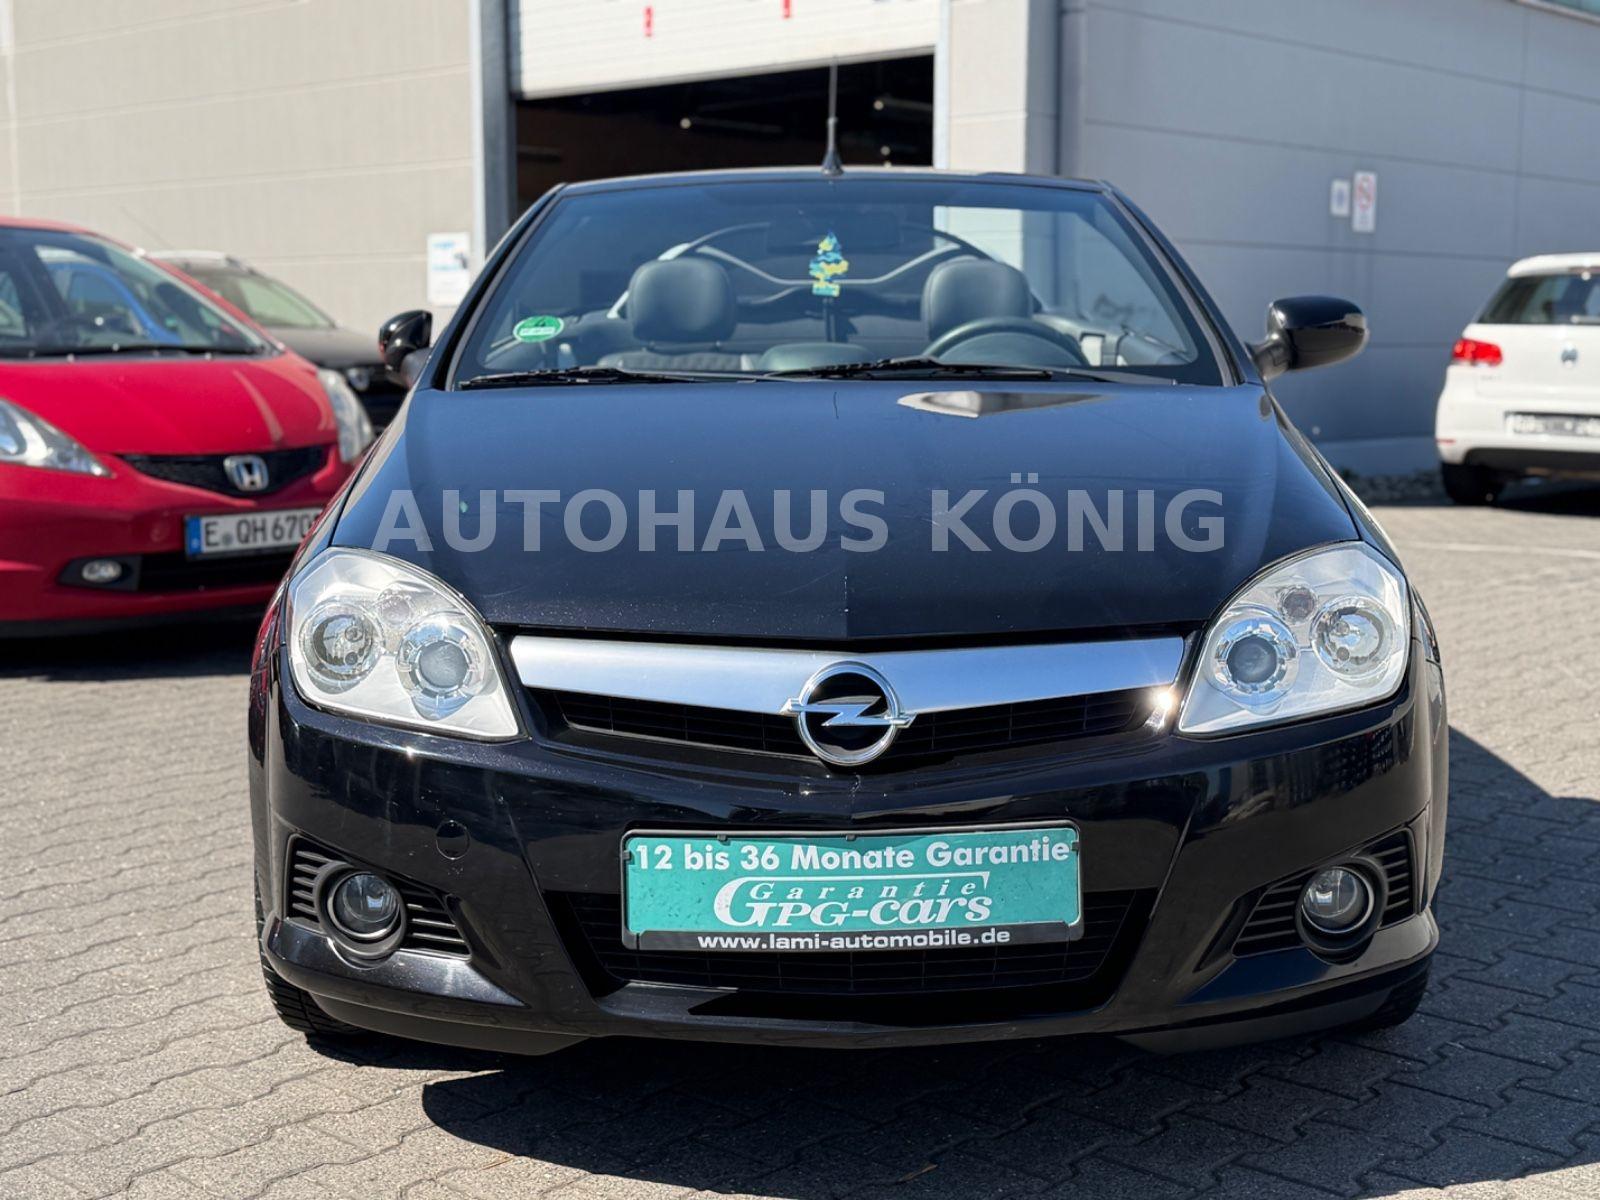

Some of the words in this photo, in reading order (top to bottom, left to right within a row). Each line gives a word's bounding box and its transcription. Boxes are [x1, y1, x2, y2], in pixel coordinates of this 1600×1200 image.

[204, 521, 219, 547] E
[236, 518, 268, 545] QH
[271, 513, 319, 541] 670
[636, 844, 673, 870] 12
[684, 843, 730, 870] bis
[740, 844, 780, 870] 36
[790, 844, 915, 871] Monate
[926, 835, 1070, 868] Garantie
[750, 878, 977, 900] Garantie
[697, 928, 1011, 950] www.lami-automobile.de
